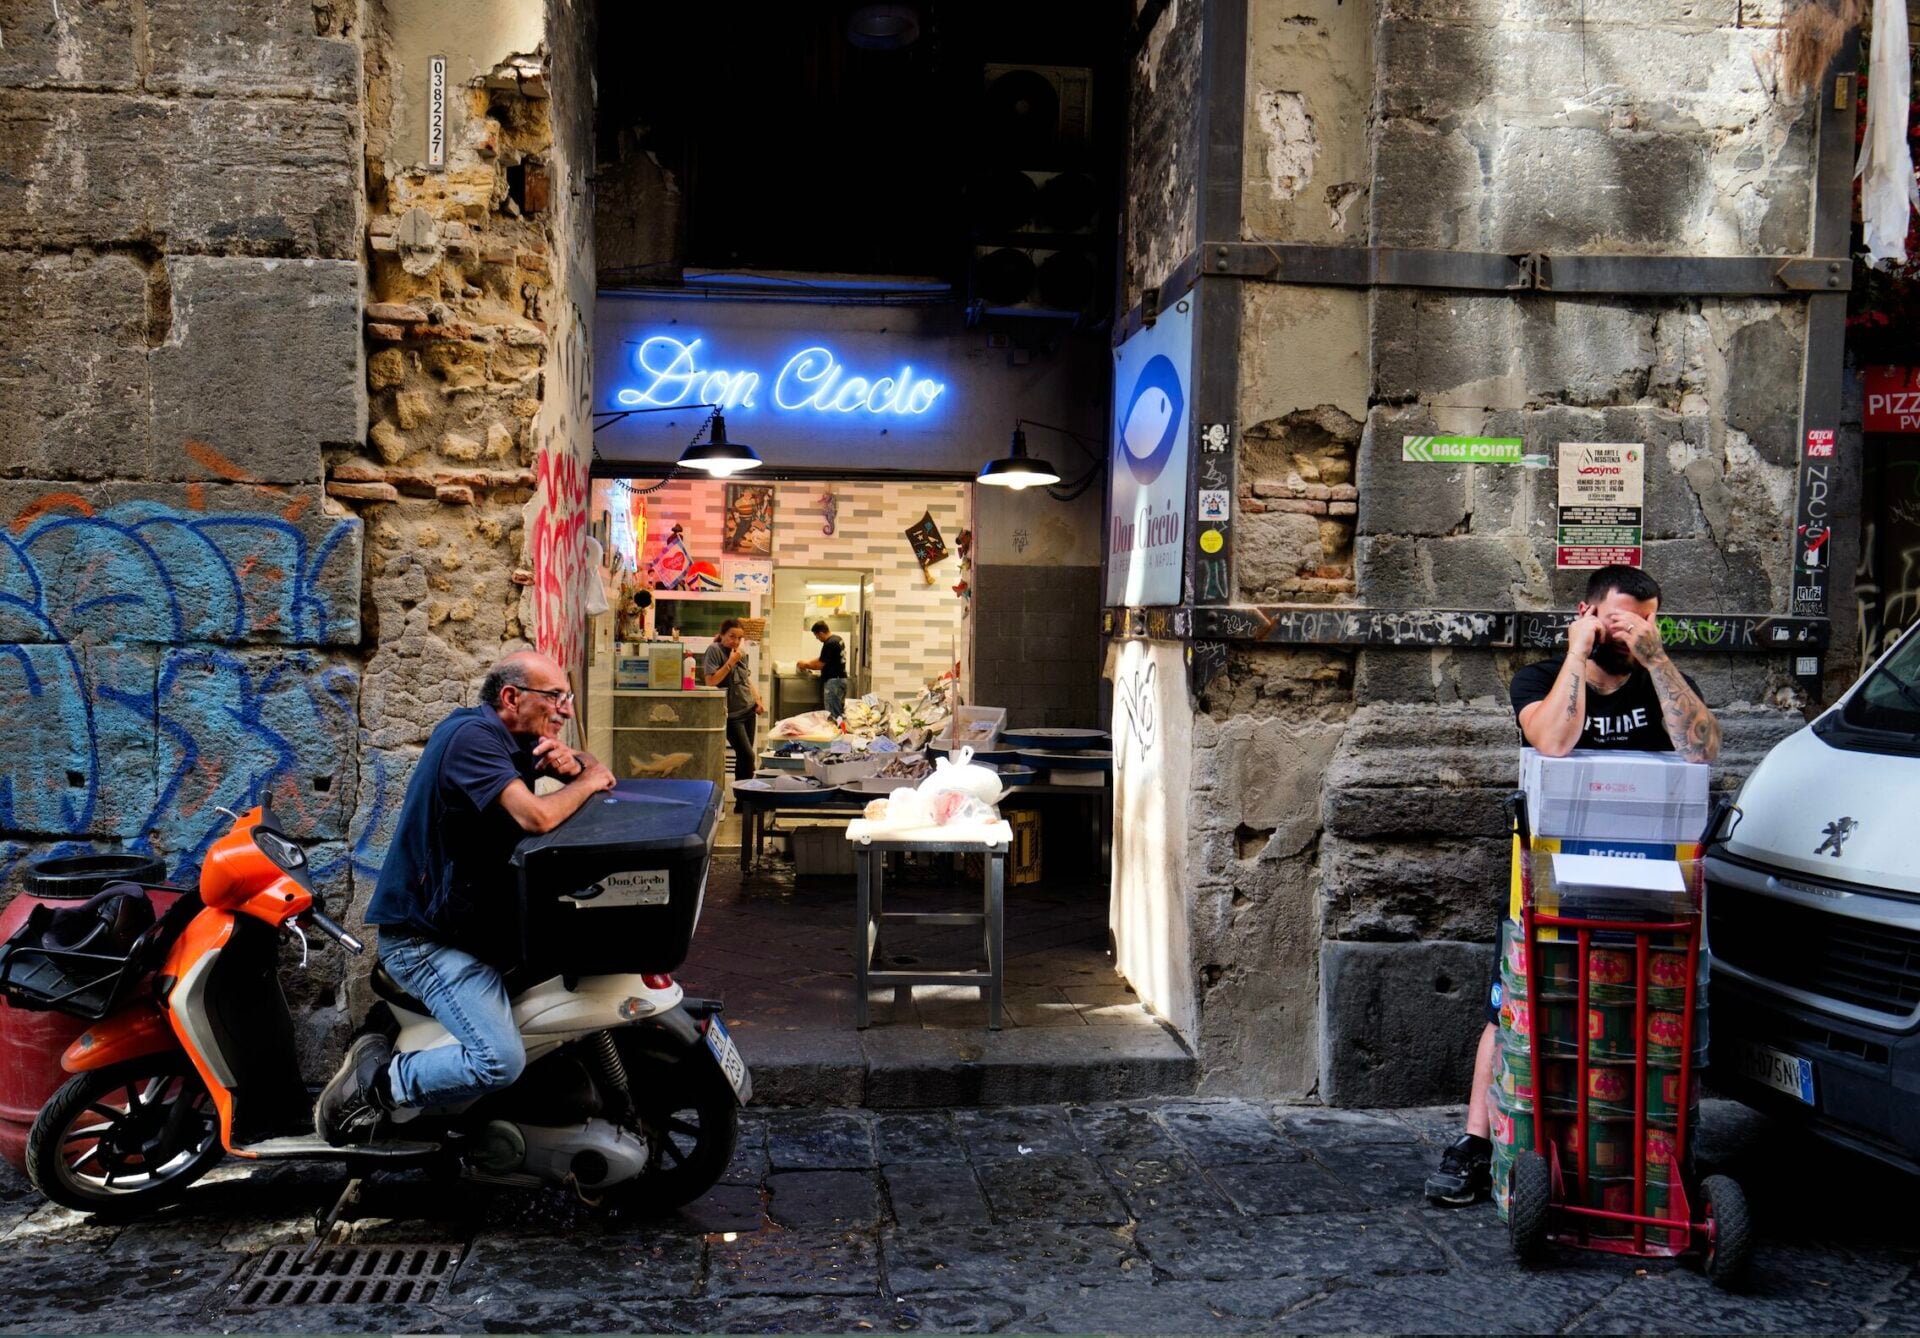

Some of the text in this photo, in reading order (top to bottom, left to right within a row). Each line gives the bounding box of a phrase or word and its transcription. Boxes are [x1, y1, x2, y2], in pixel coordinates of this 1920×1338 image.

[432, 62, 443, 153] 0382227
[617, 336, 760, 408] Don
[775, 347, 945, 414] Ciccio
[1432, 444, 1520, 457] BAGS POINTS
[1808, 444, 1833, 456] LOVE
[1139, 499, 1179, 549] Ciccio
[608, 877, 631, 886] Don
